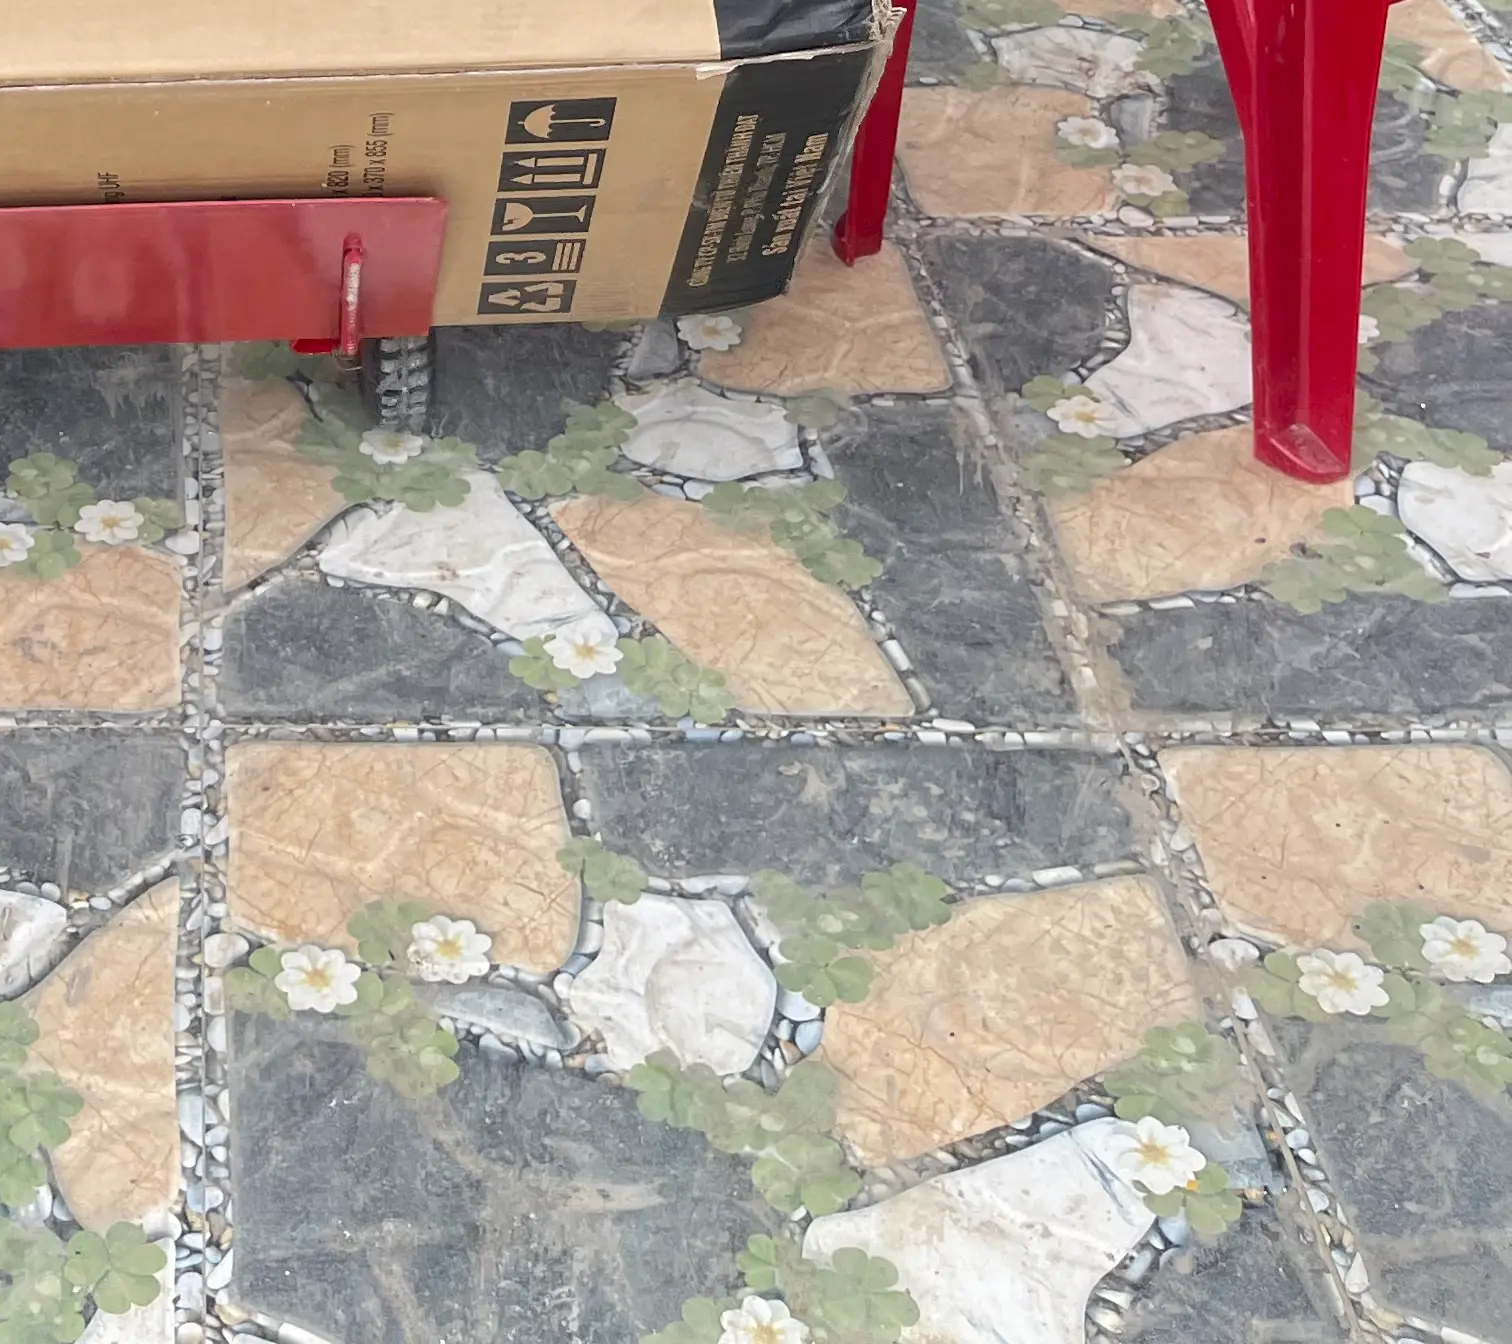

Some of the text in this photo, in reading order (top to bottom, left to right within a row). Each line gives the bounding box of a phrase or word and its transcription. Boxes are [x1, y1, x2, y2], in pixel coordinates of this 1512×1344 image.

[366, 111, 397, 138] (mm)
[327, 144, 357, 169] (mm)
[364, 139, 388, 158] 855
[97, 171, 121, 190] UHF
[326, 170, 350, 188] 820
[362, 166, 386, 185] 370
